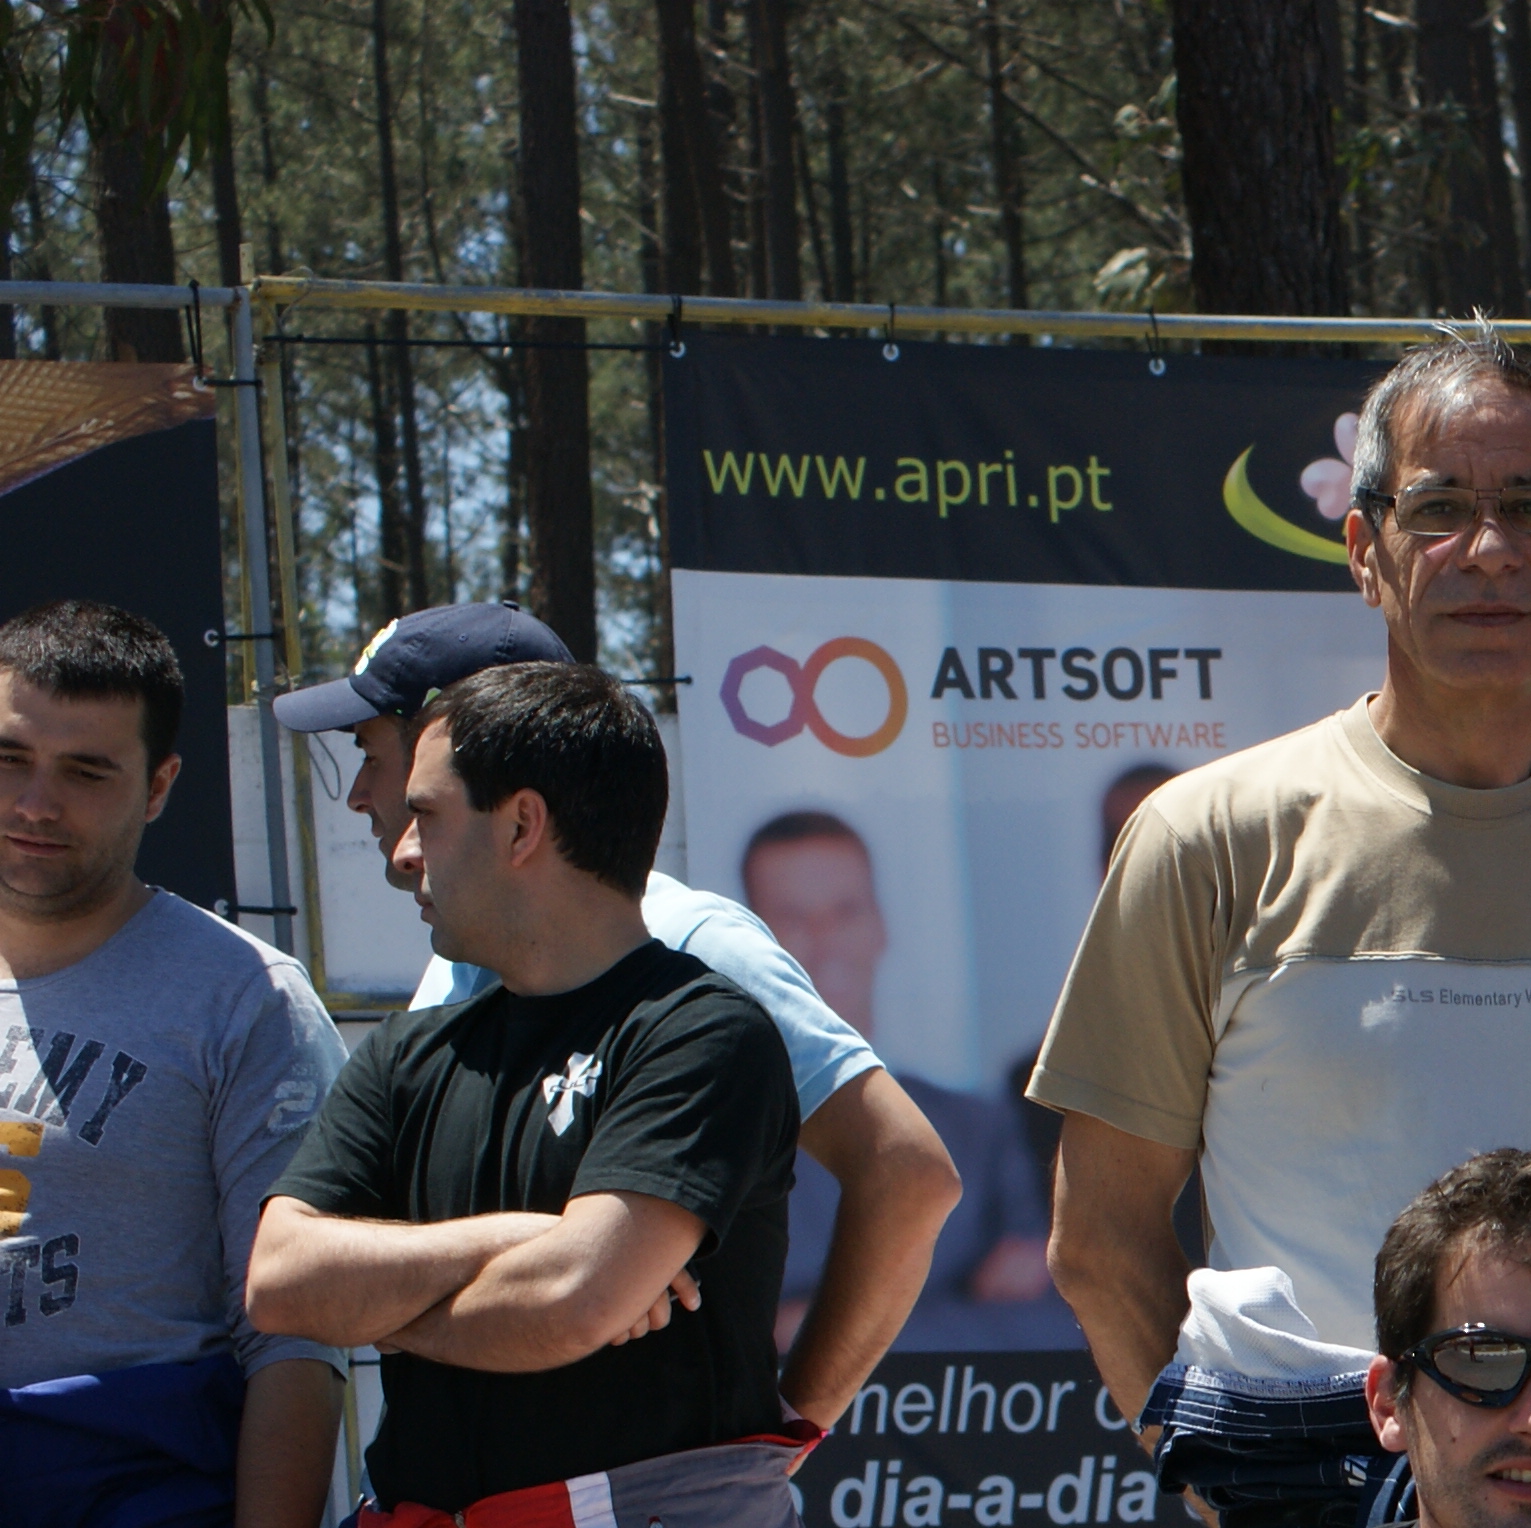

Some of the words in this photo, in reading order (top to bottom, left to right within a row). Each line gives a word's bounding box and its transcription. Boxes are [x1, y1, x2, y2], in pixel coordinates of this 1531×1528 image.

[703, 449, 1113, 523] www.apri.pt
[930, 646, 1223, 701] ARTSOFT
[932, 721, 1064, 749] BUSINESS
[1073, 721, 1227, 749] SOFTWARE
[1440, 988, 1523, 1009] Elementary
